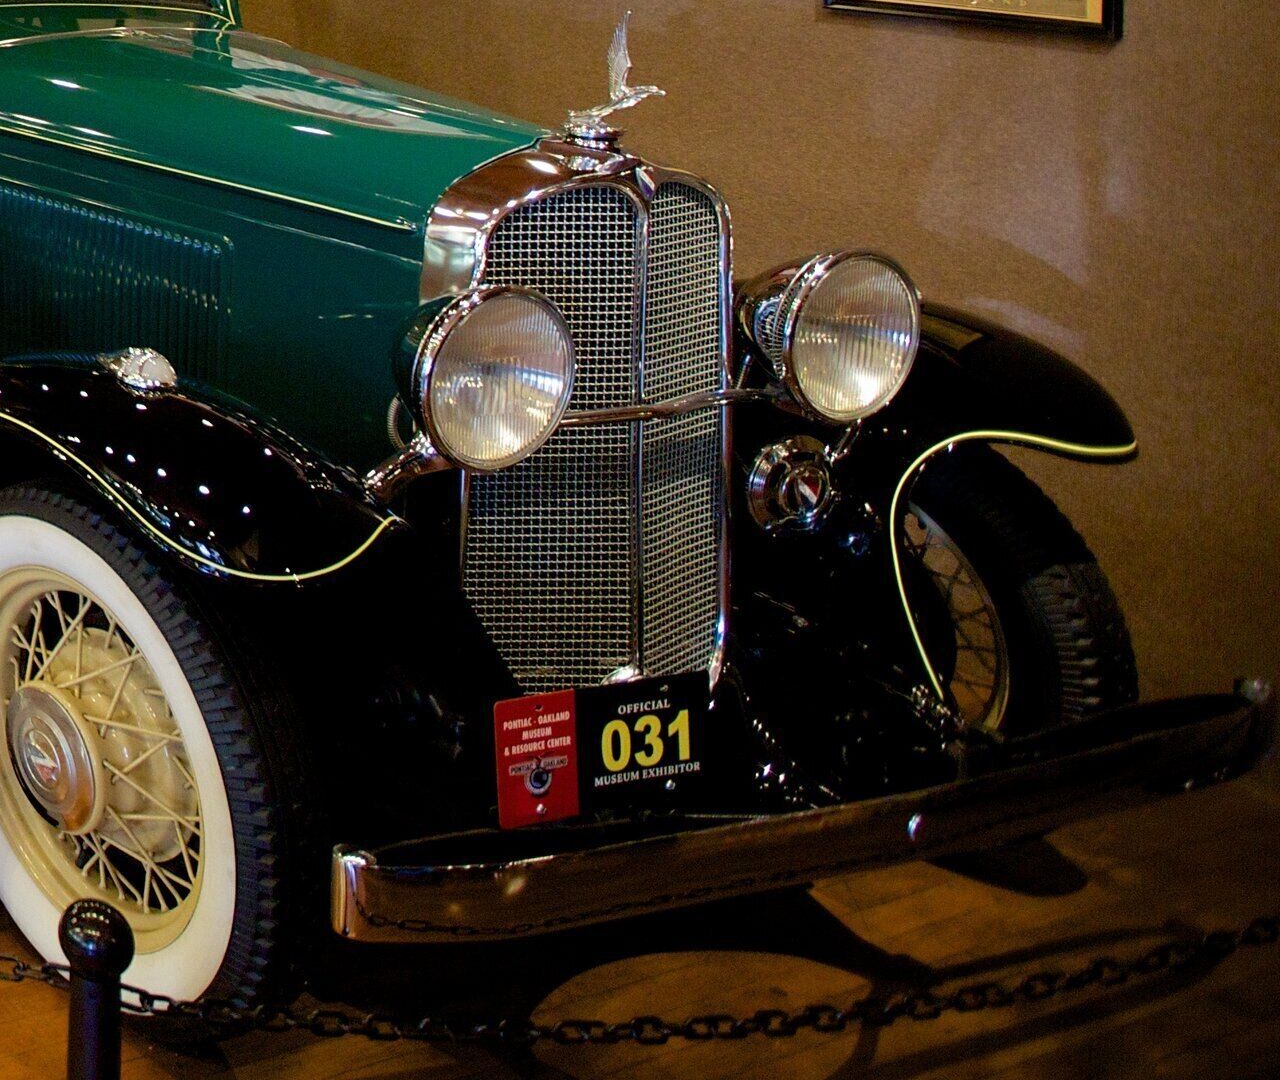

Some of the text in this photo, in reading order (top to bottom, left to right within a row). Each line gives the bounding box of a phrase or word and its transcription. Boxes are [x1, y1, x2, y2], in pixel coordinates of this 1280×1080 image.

[618, 699, 670, 715] OFFICIAL
[503, 717, 532, 731] PONTIAC
[538, 710, 570, 724] OAKLAND
[522, 727, 552, 740] MUSEUM
[601, 709, 691, 772] 031
[511, 741, 545, 755] RESOURCE
[546, 736, 571, 749] CENTER
[594, 761, 701, 787] MUSEUM EXHIBITOR
